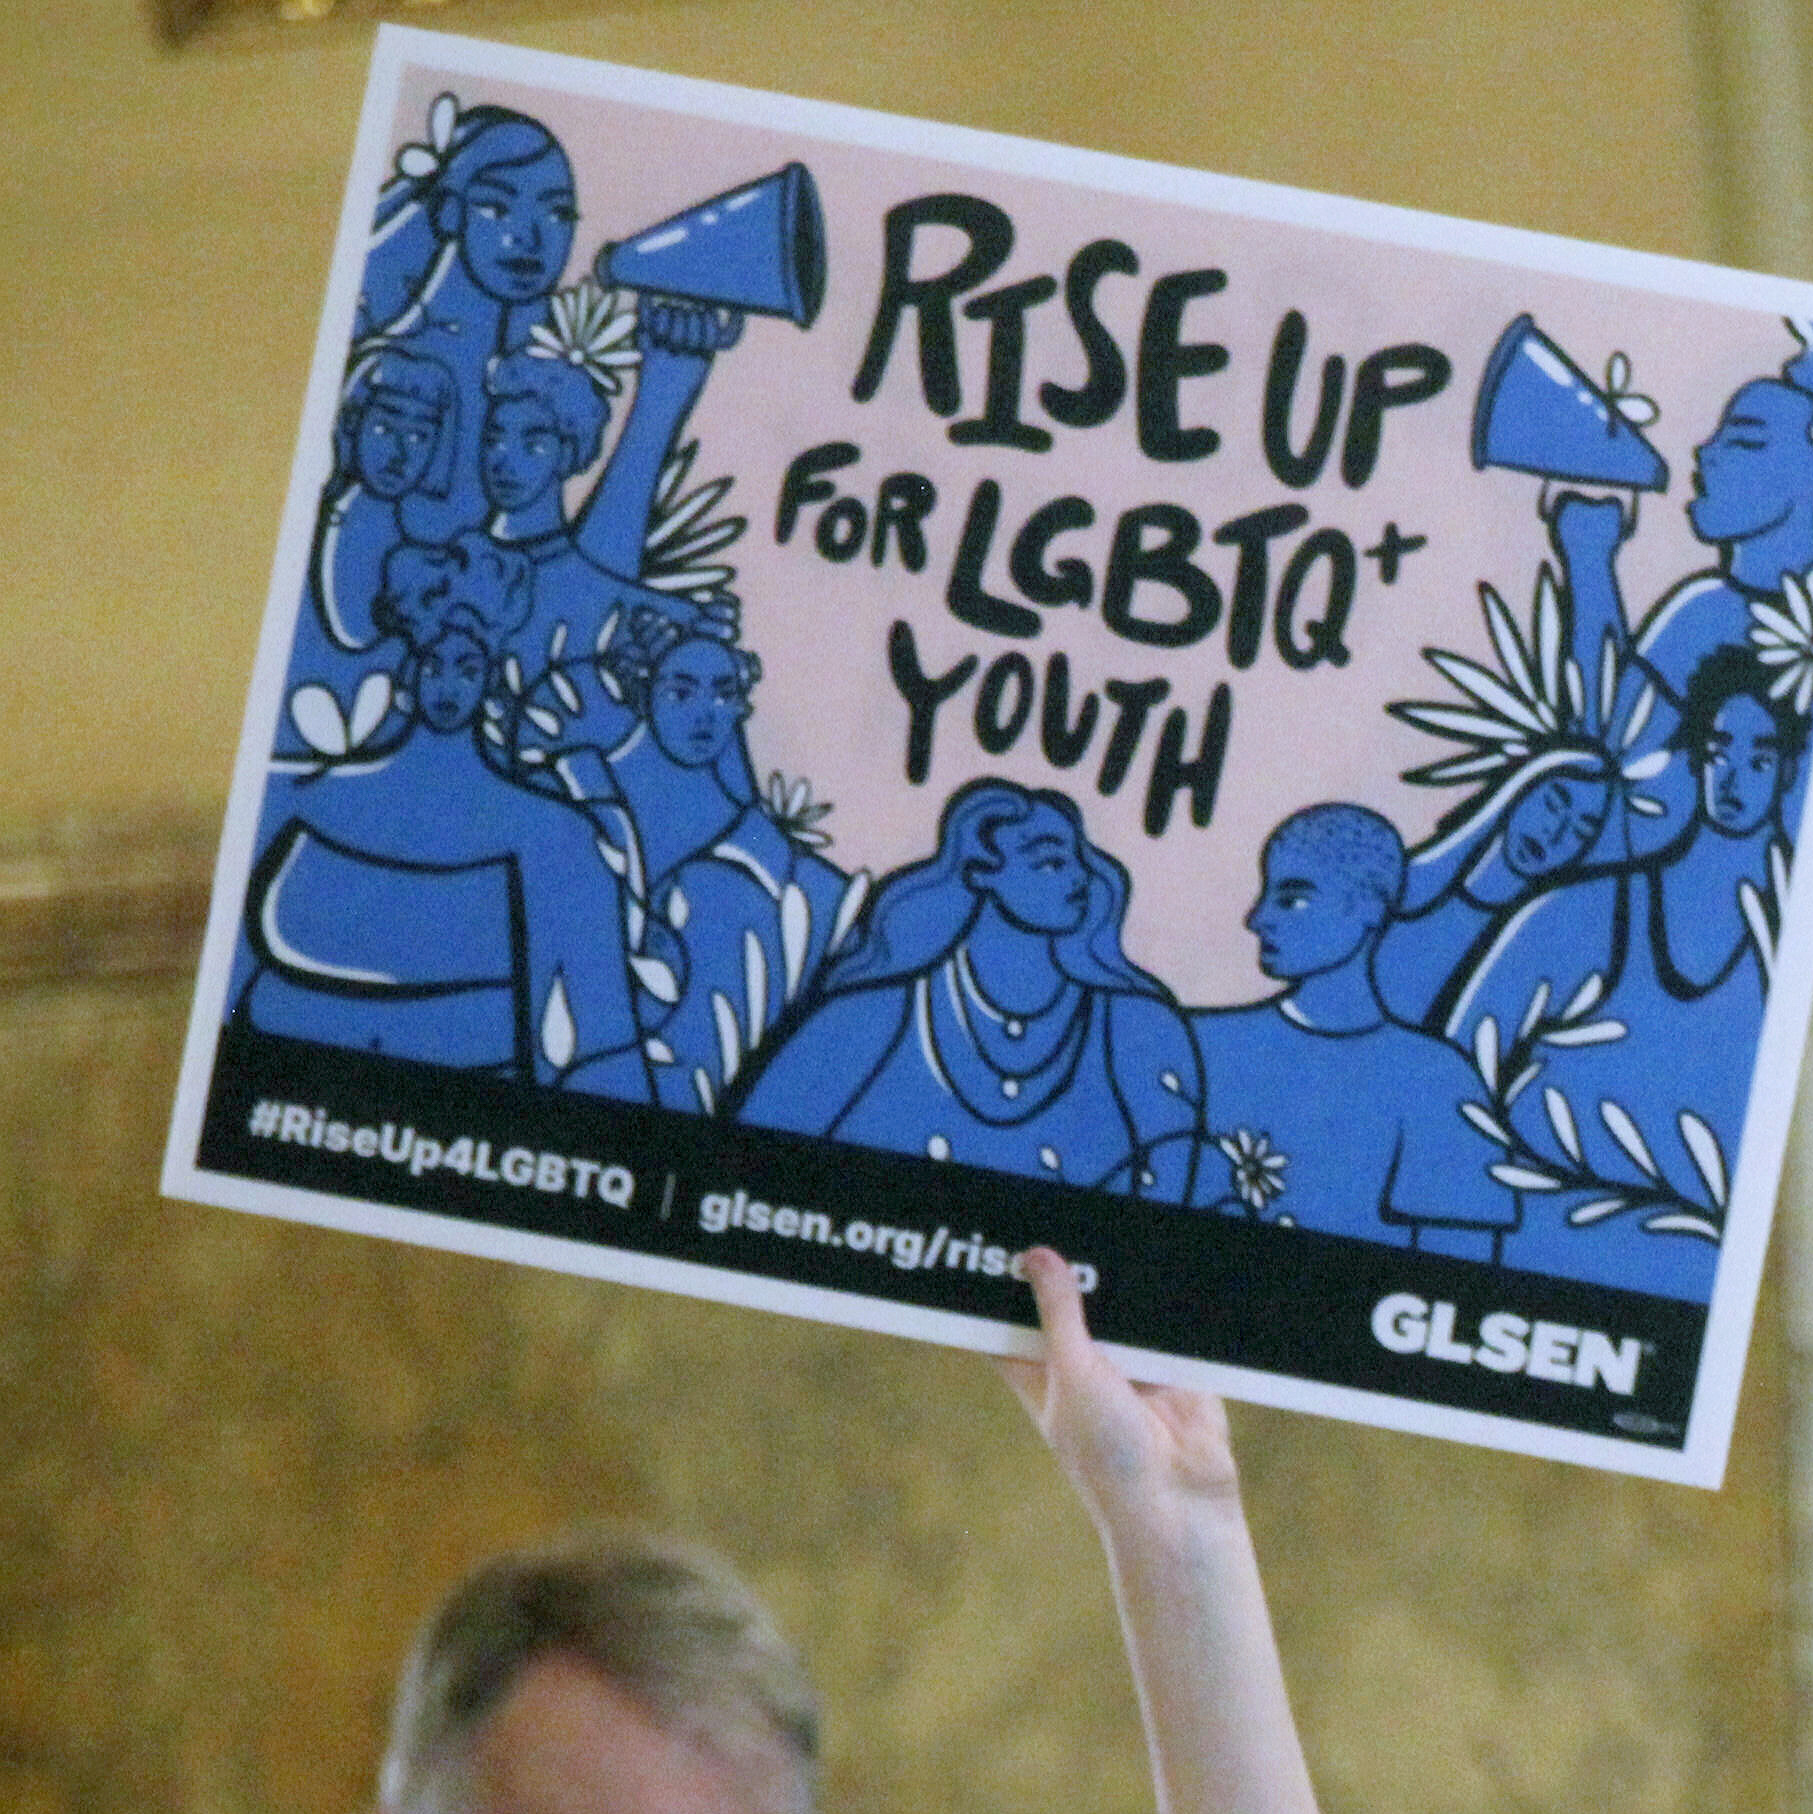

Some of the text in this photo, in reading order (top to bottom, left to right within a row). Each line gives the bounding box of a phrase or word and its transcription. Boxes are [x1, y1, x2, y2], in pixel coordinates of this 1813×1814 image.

[852, 193, 1452, 489] RISE UP
[775, 441, 1428, 671] FOR LGBTQ+
[887, 619, 1232, 838] YOUTH
[247, 1098, 1099, 1296] #RiseUp4LGBTQ glsen.org/risp
[1371, 1291, 1641, 1397] GLSEN
